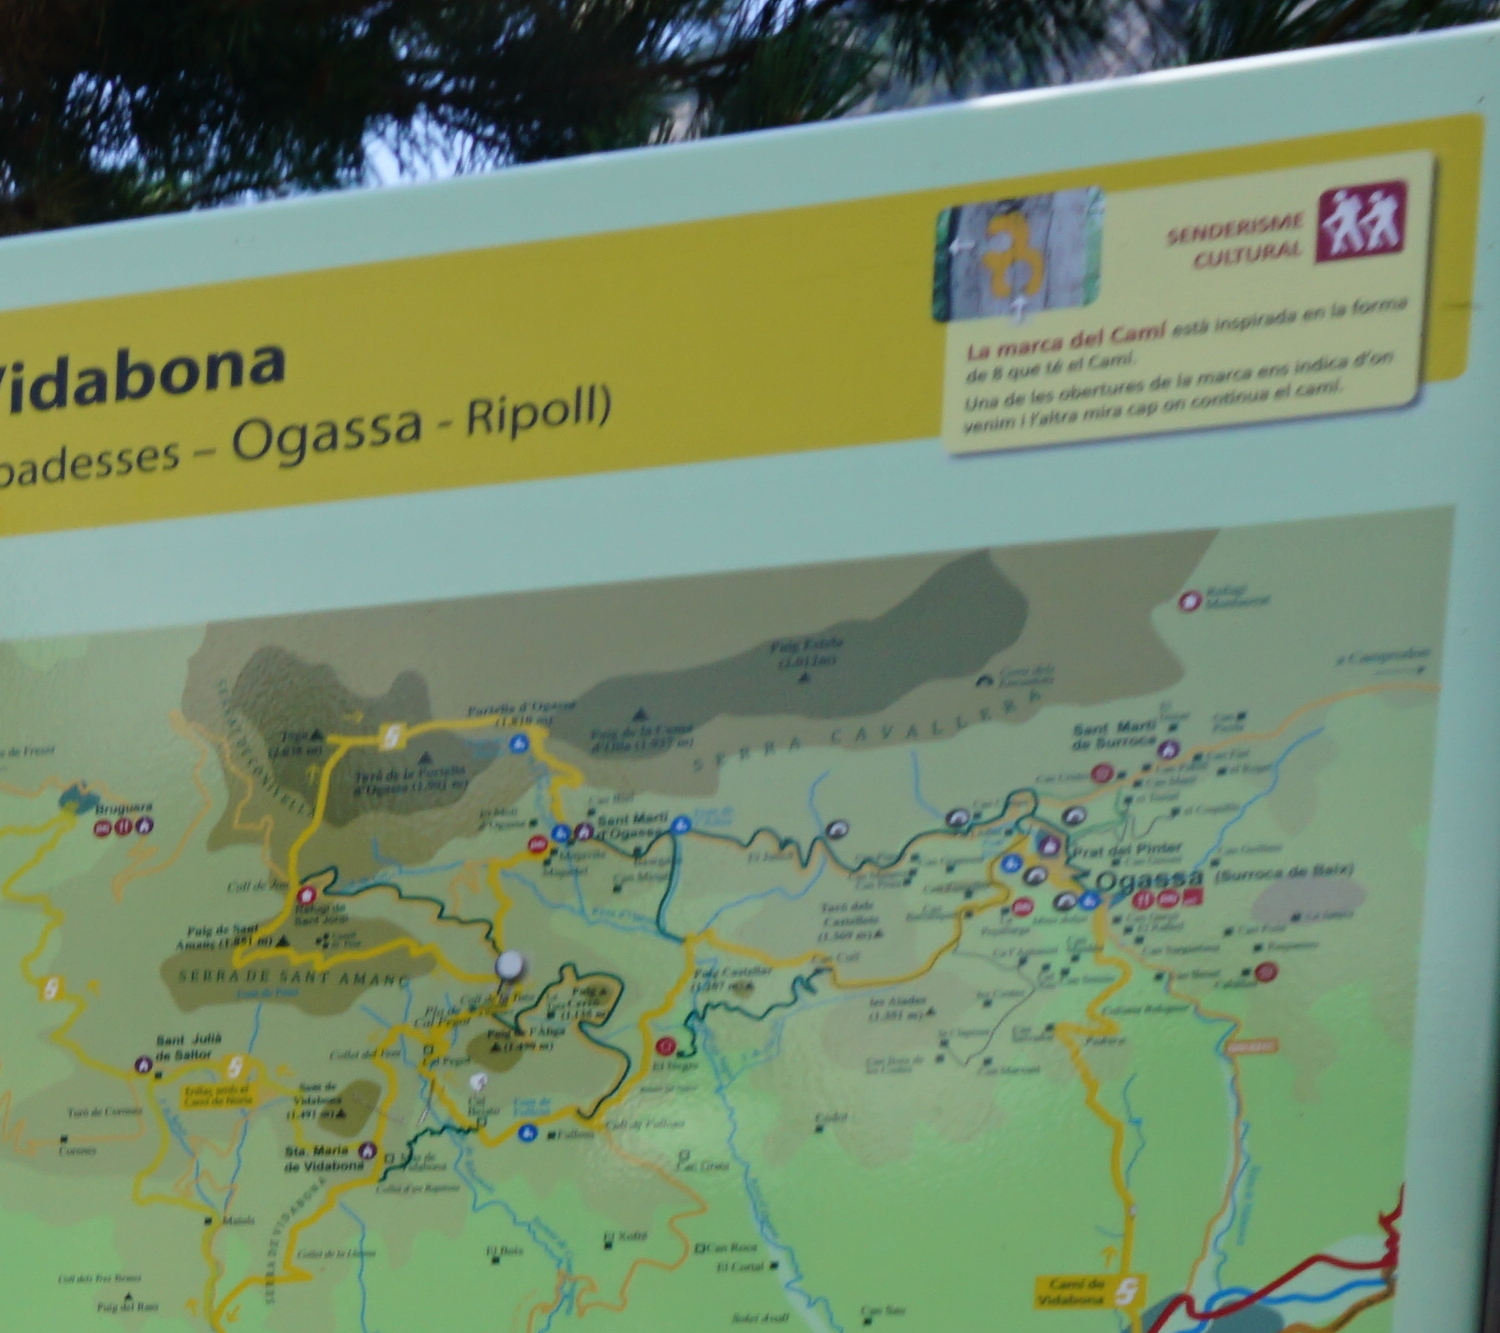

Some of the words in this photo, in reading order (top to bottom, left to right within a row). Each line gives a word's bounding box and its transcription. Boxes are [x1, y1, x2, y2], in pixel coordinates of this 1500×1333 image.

[1166, 212, 1303, 245] SENDERISME
[231, 411, 422, 468] Ogassa
[467, 385, 611, 440] Ripoll)
[1096, 868, 1205, 895] Ogassa
